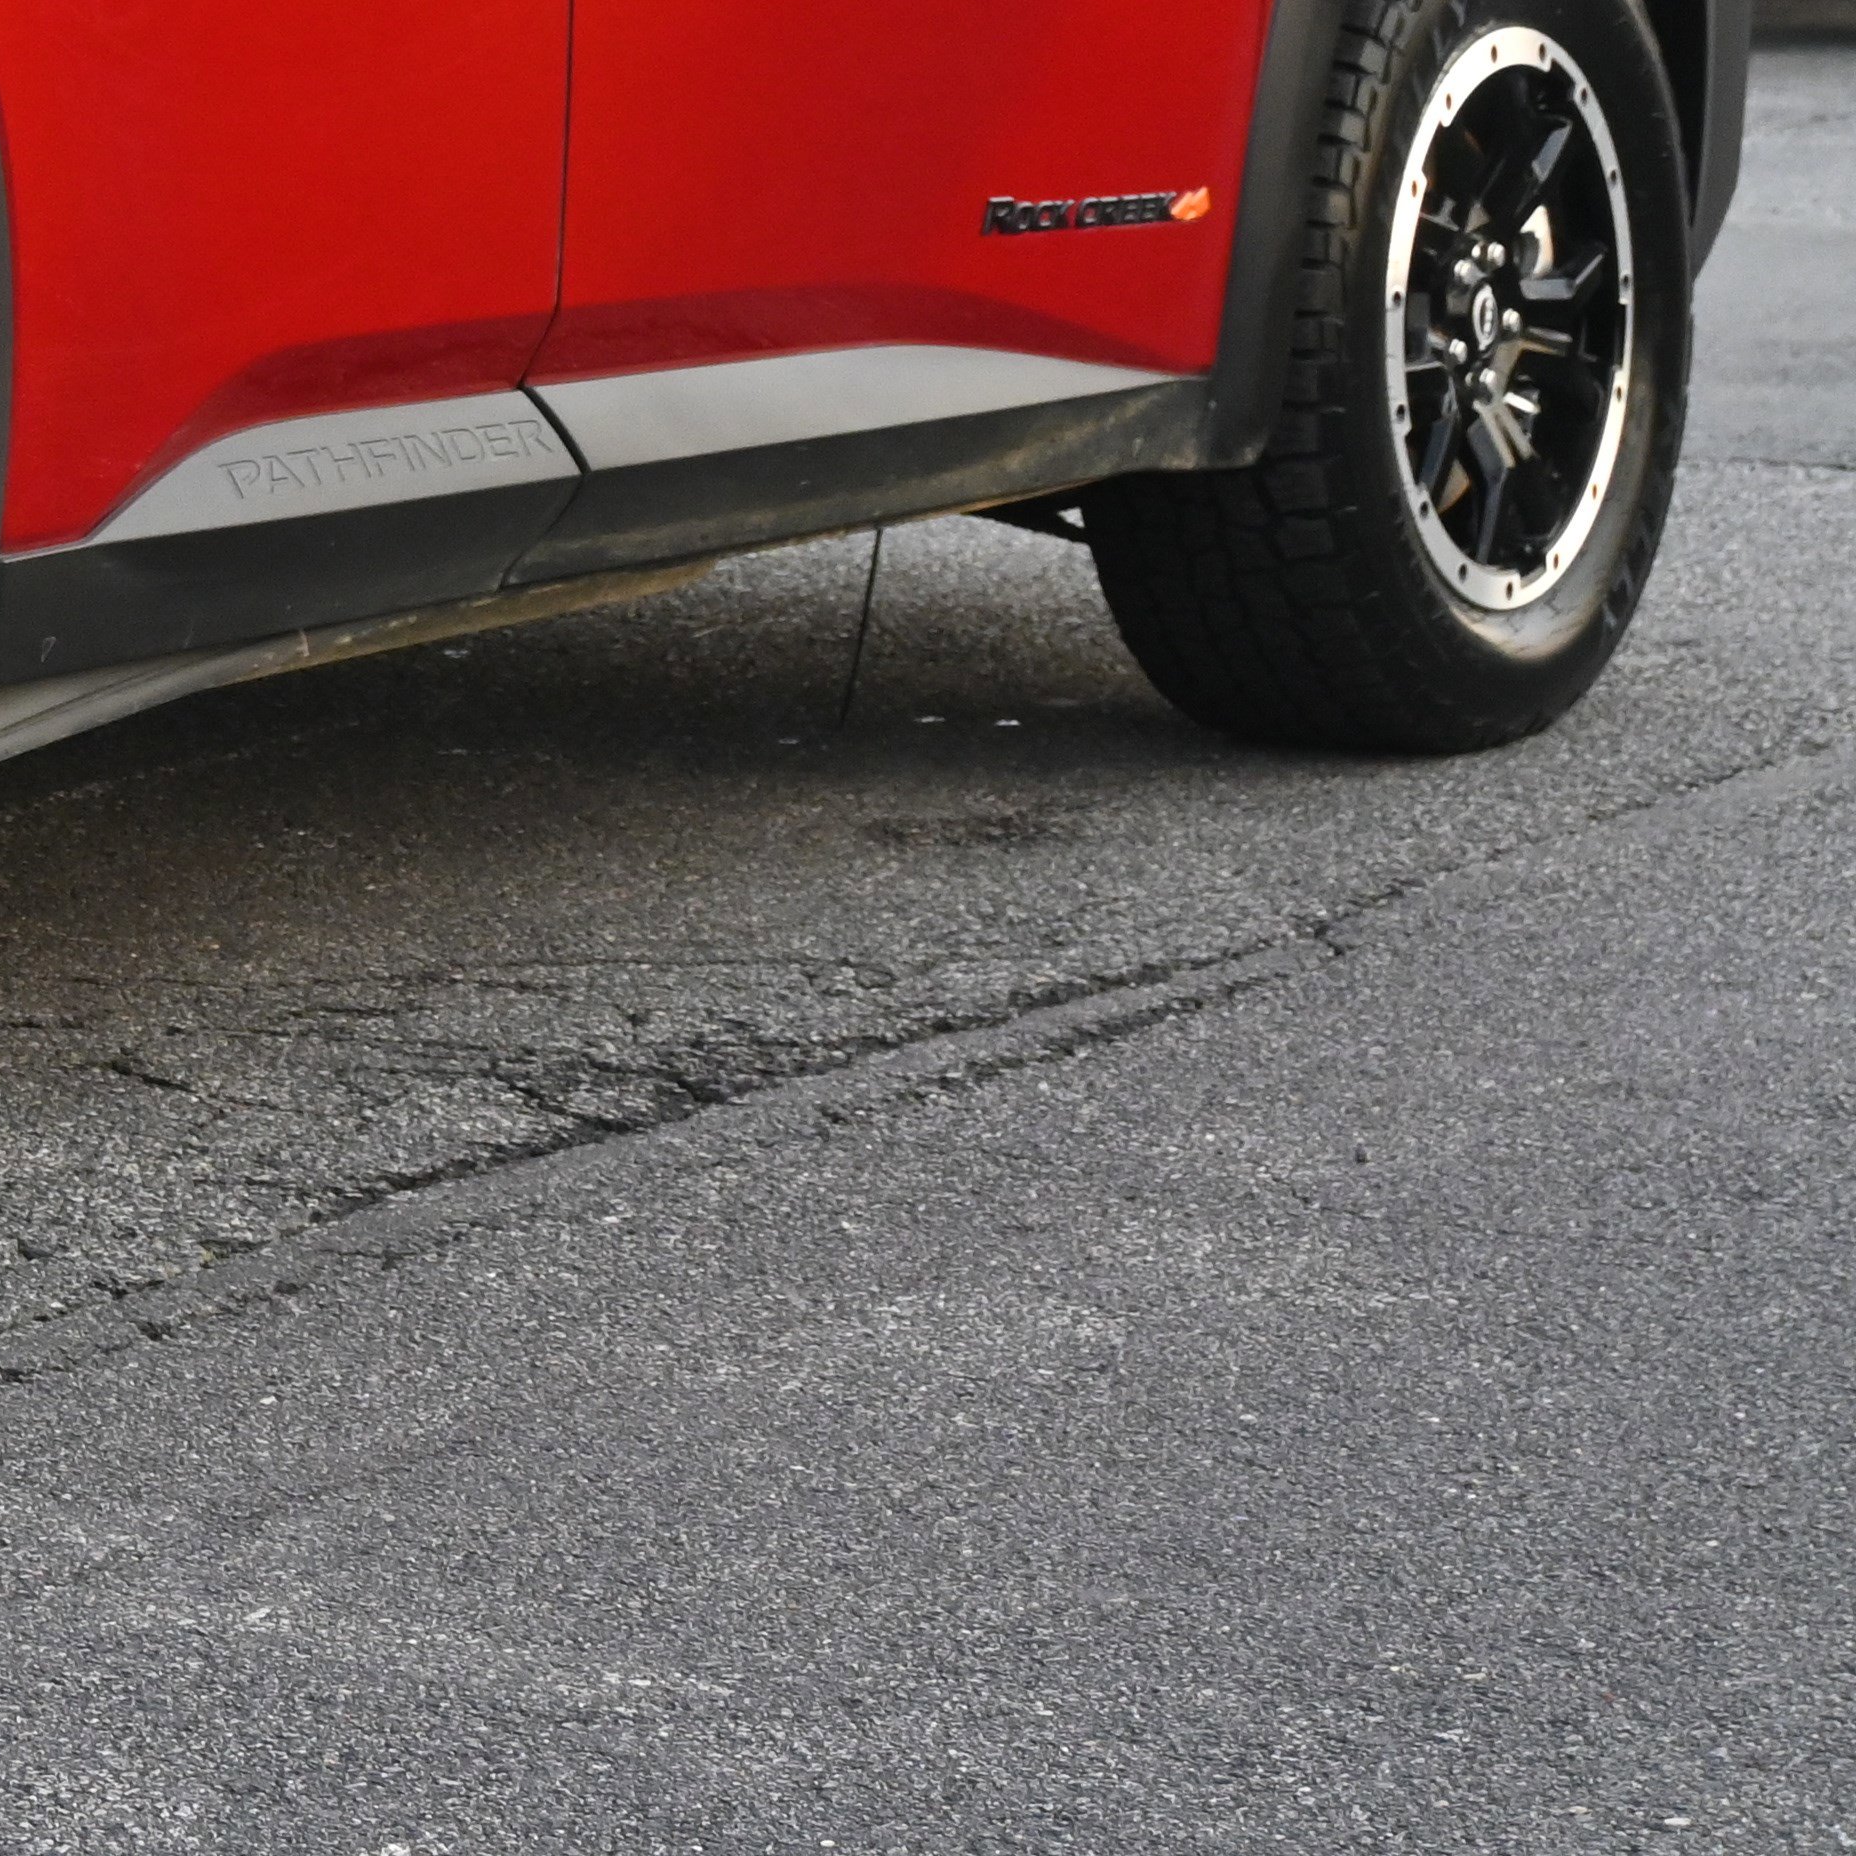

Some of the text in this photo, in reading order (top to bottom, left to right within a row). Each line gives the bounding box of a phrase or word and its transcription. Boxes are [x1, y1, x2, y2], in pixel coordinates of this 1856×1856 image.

[981, 191, 1178, 236] ROCK CREEK
[217, 419, 553, 500] PATHFINDER
